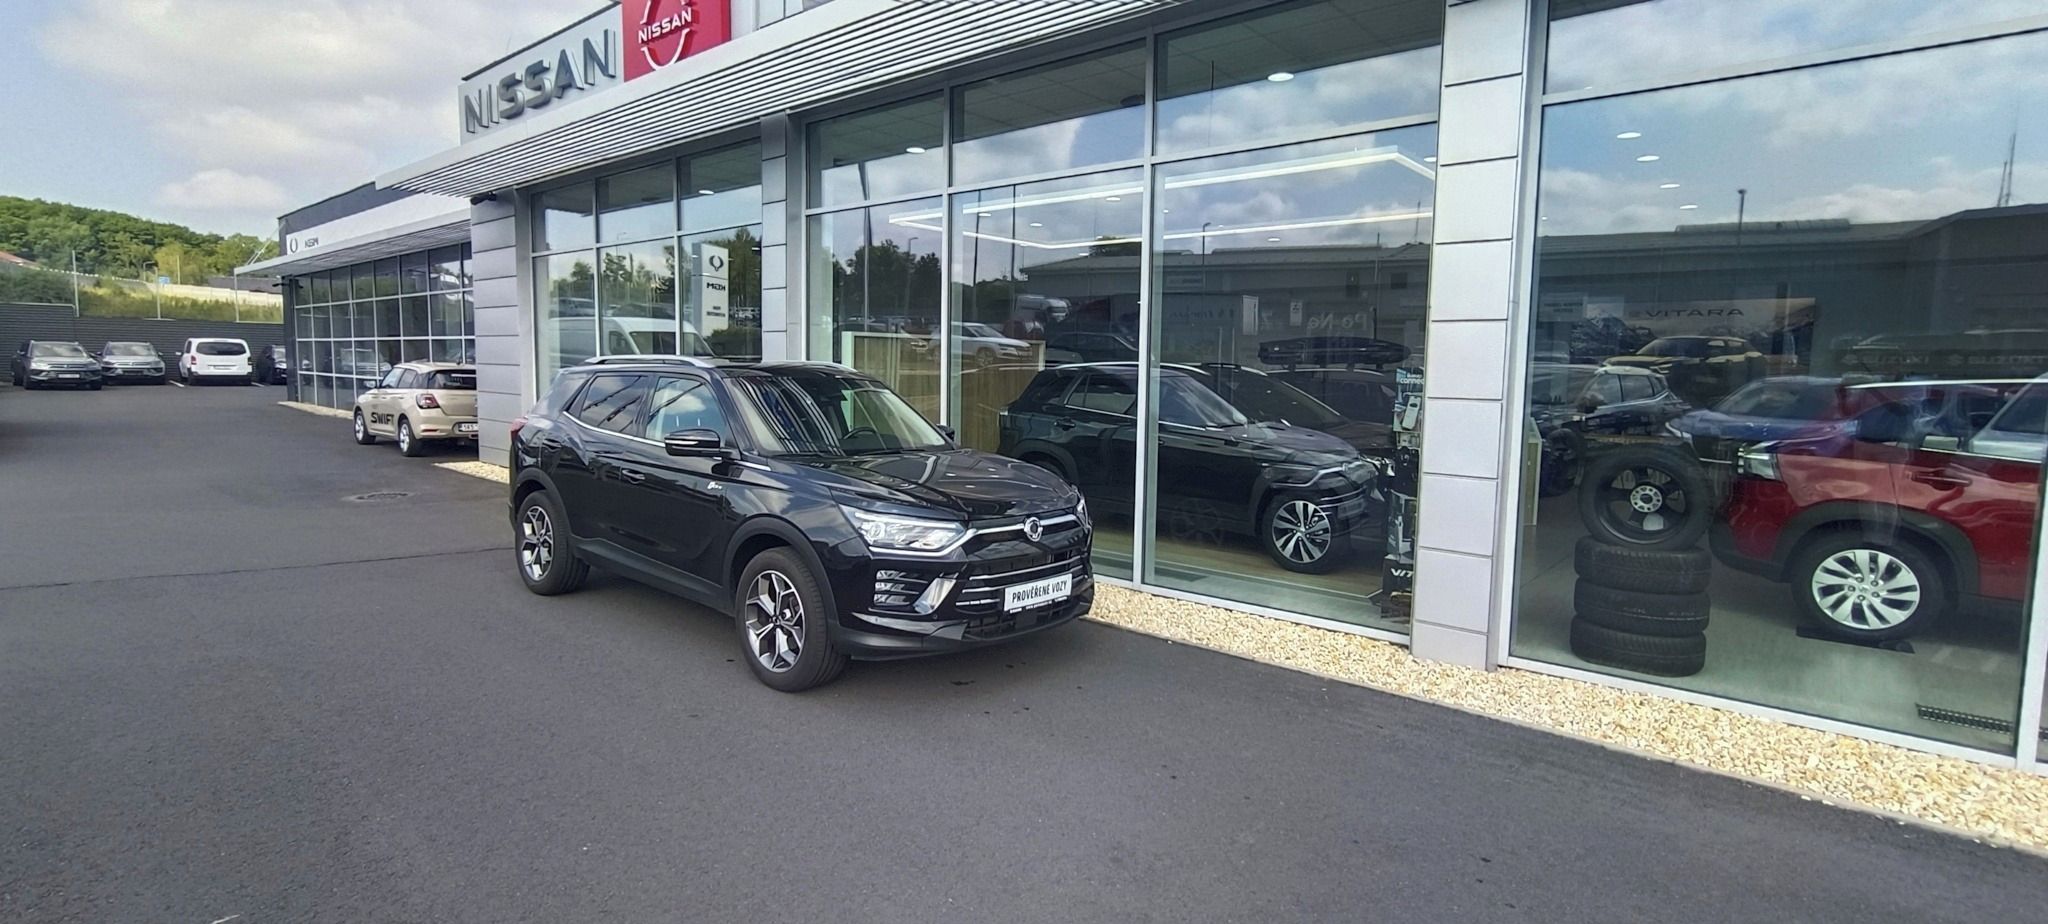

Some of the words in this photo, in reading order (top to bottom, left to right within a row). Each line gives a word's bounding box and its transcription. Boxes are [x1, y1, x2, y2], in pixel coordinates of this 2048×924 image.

[638, 8, 692, 43] NISSAN
[464, 29, 616, 134] NISSAN
[1645, 308, 1744, 317] VITARA
[371, 412, 395, 424] SWIFT
[1012, 583, 1051, 603] PROVĚŘENÉ
[1051, 580, 1068, 593] VOZY
